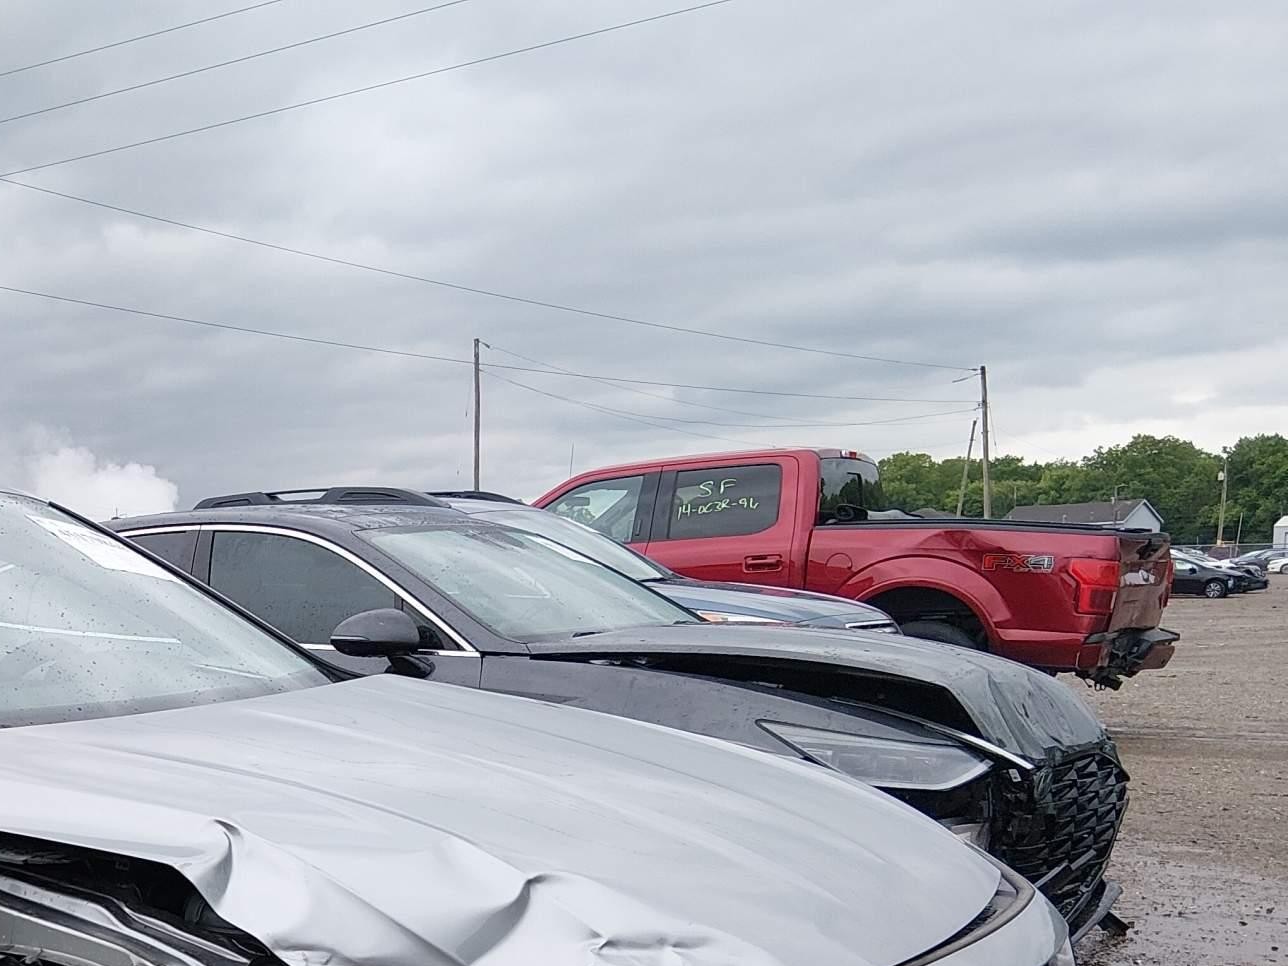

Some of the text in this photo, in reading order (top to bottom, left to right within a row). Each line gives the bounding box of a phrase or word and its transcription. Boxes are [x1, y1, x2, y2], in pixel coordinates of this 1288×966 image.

[697, 478, 737, 497] S F
[982, 554, 1054, 570] FX4
